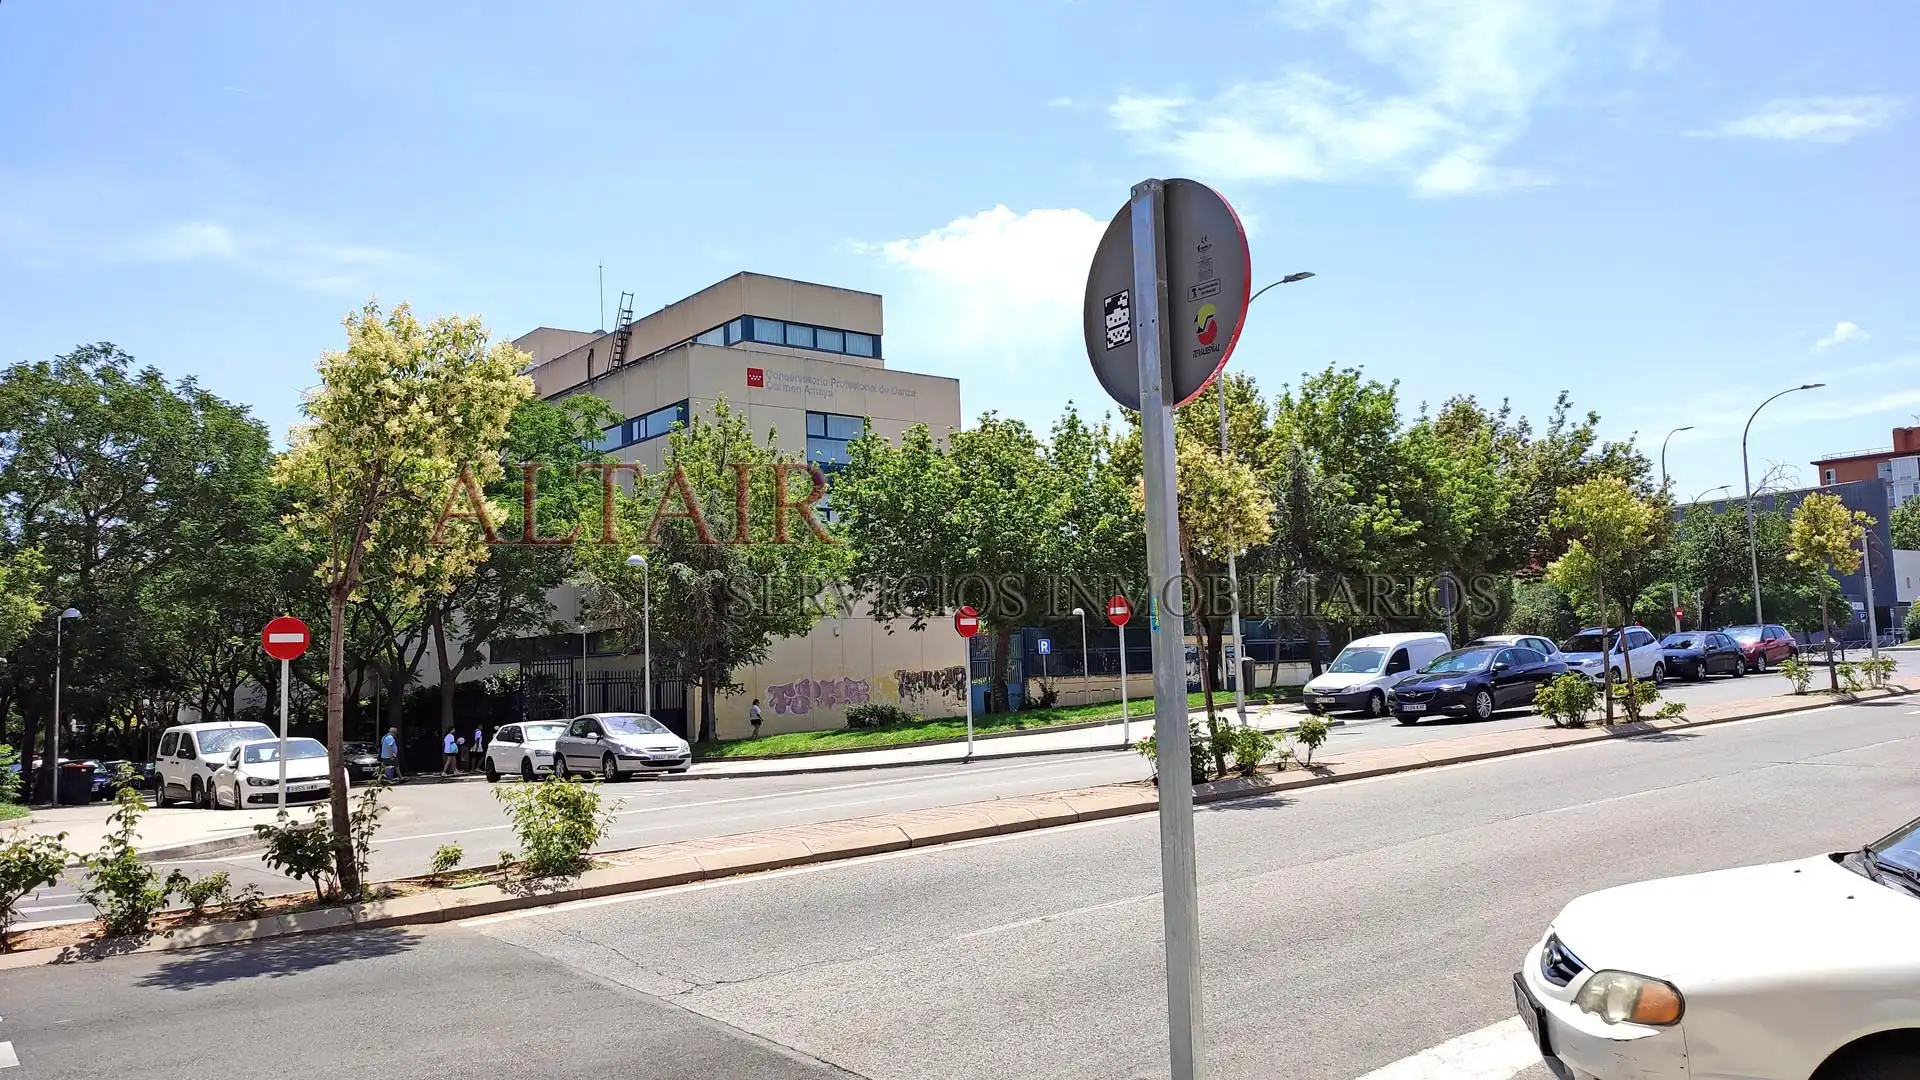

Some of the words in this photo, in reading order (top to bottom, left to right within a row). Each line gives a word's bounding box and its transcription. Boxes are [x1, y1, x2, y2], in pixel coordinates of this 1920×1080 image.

[766, 370, 828, 388] Conservatorio
[830, 377, 878, 394] Profesional
[878, 384, 891, 394] de
[891, 385, 916, 398] Danza
[766, 380, 801, 394] Carmen
[803, 386, 834, 399] Amaya
